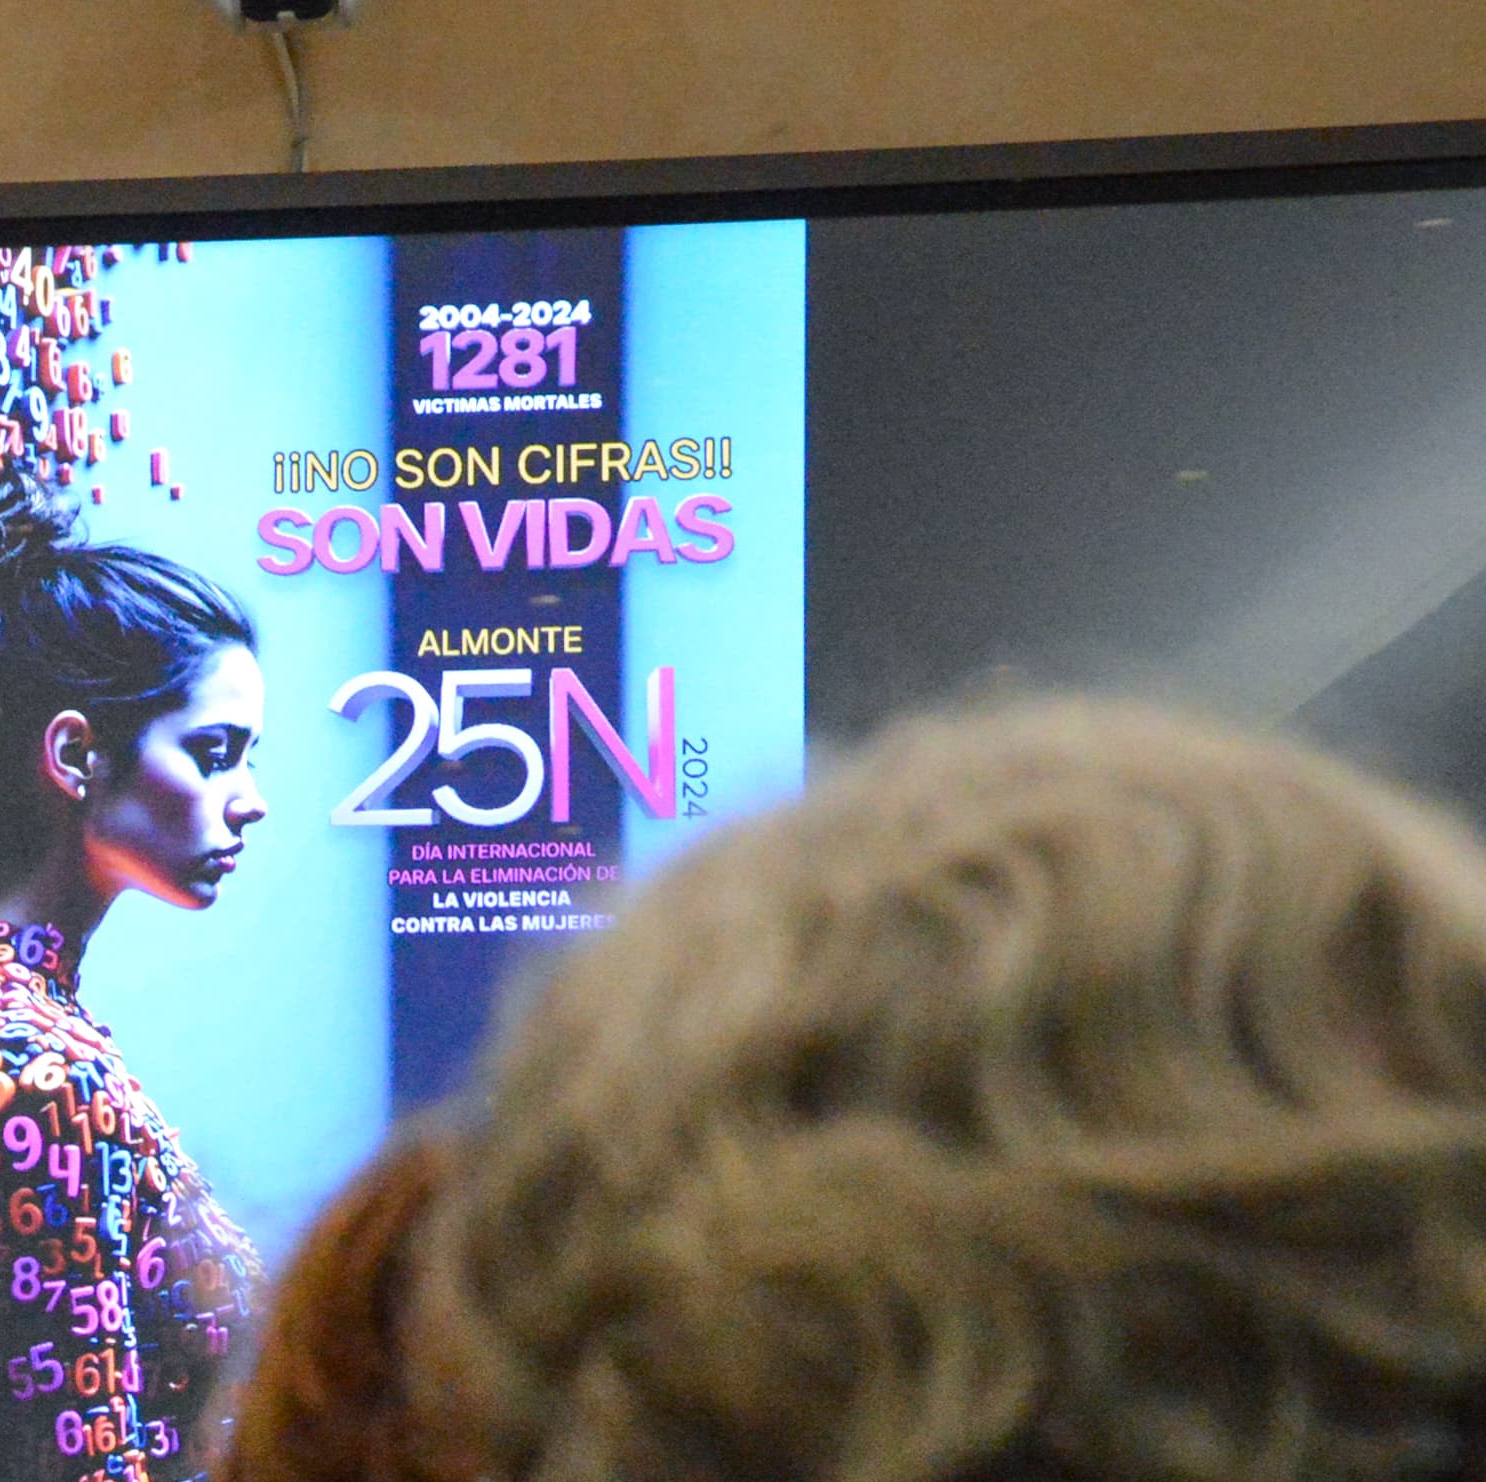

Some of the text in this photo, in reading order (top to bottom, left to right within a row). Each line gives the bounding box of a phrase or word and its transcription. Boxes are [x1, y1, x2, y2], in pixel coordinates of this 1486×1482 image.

[419, 300, 592, 330] 2004-2024
[419, 326, 579, 391] 1281
[413, 392, 602, 414] VICTIMAS MORTALES
[395, 444, 501, 489] SON
[518, 437, 734, 486] CIFRAS!!
[257, 494, 736, 576] SON VIDAS
[418, 626, 583, 656] ALMONTE
[328, 666, 677, 827] 25N
[682, 737, 709, 819] 2024
[412, 841, 596, 861] DÍA INTERNACIONAL
[388, 868, 438, 886] PARA
[442, 868, 466, 884] LA
[471, 863, 592, 884] ELIMINACIÓN
[433, 890, 572, 909] LA VIOLENCIA
[391, 916, 475, 934] CONTRA
[479, 916, 518, 932] LAS
